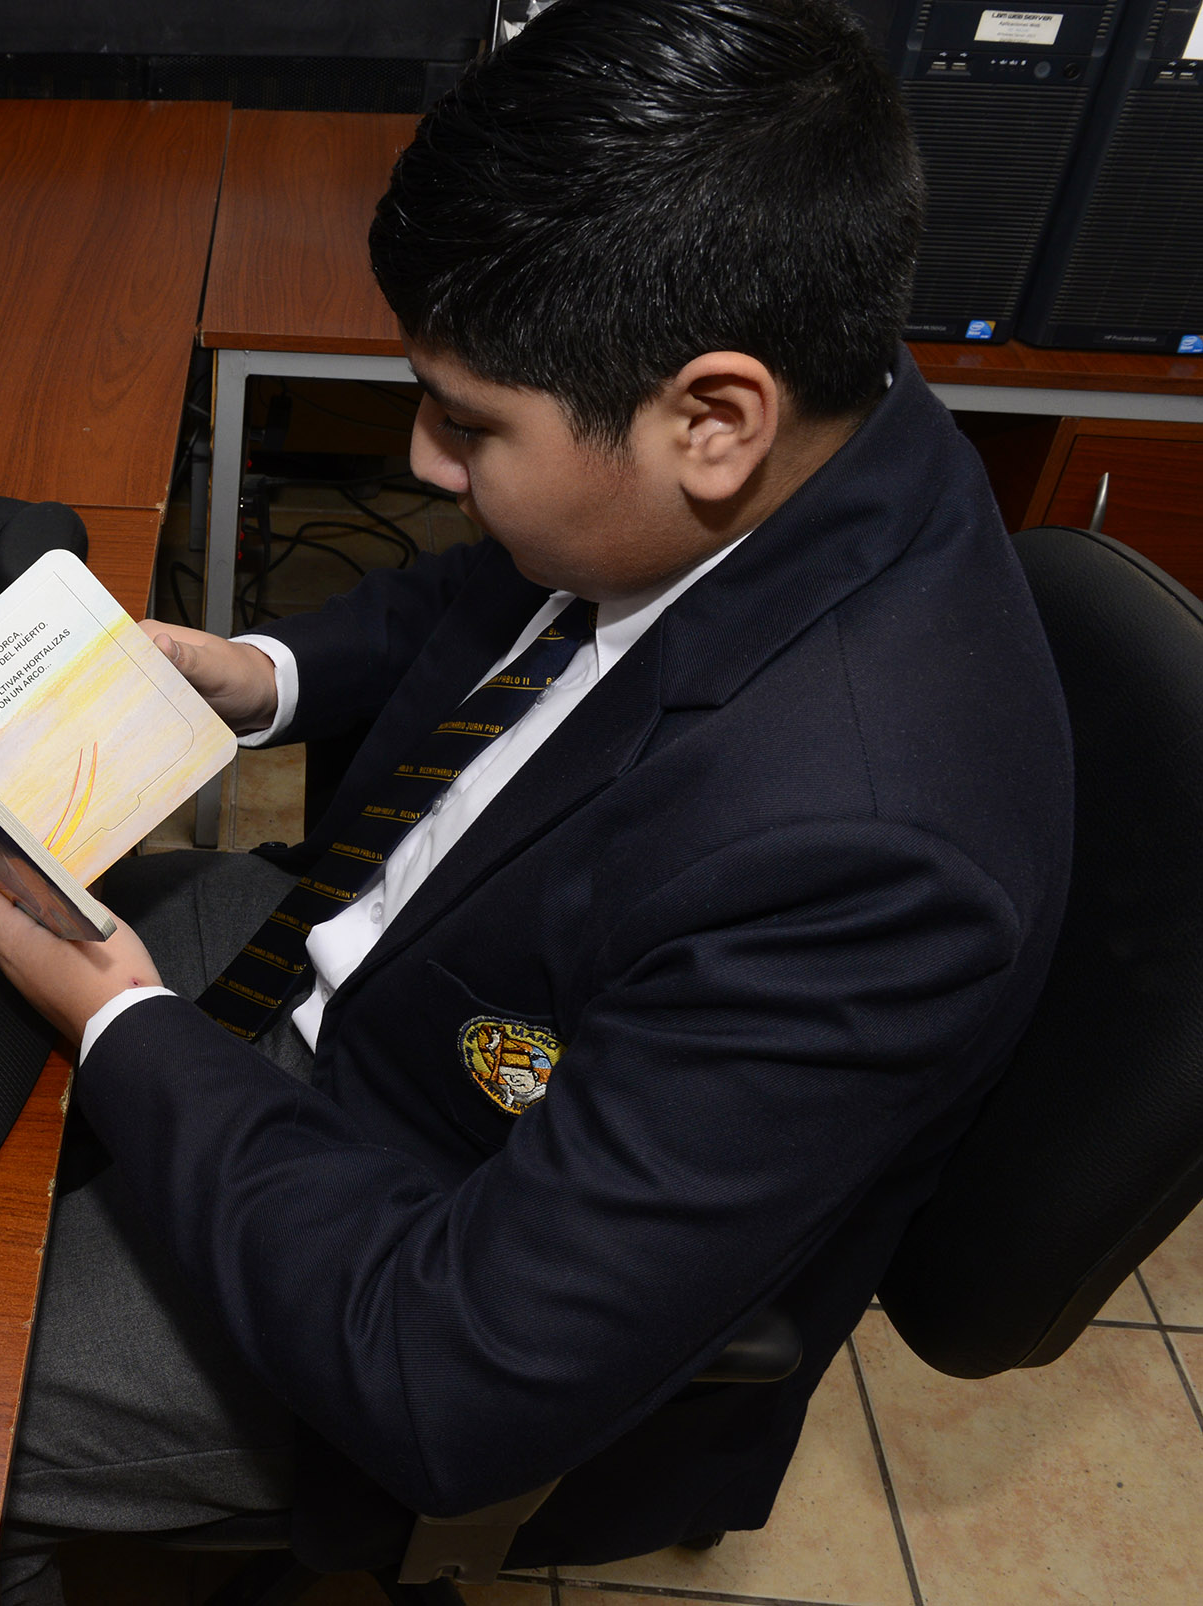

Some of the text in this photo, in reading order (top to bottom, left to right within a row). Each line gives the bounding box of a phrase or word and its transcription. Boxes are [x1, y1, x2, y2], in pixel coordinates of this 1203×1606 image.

[13, 621, 49, 652] HUERTO.
[23, 628, 71, 672] HORTALIZAS
[10, 685, 23, 698] UN
[466, 722, 483, 731] JUAN
